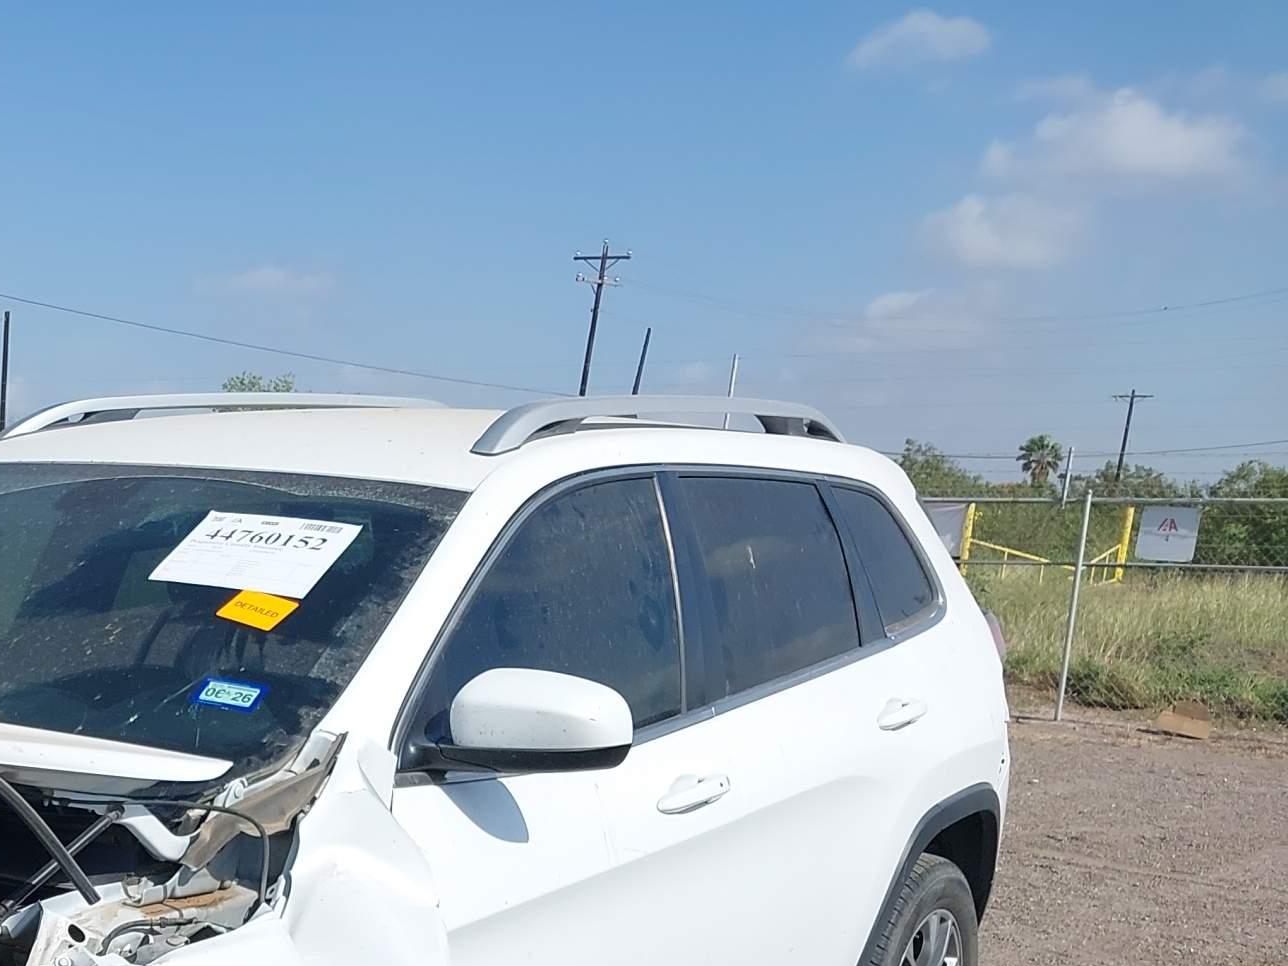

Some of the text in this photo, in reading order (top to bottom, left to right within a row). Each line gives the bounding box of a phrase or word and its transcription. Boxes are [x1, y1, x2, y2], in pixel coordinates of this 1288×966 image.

[205, 527, 328, 551] 44760152
[234, 601, 279, 619] DETAILED
[231, 691, 254, 704] 26
